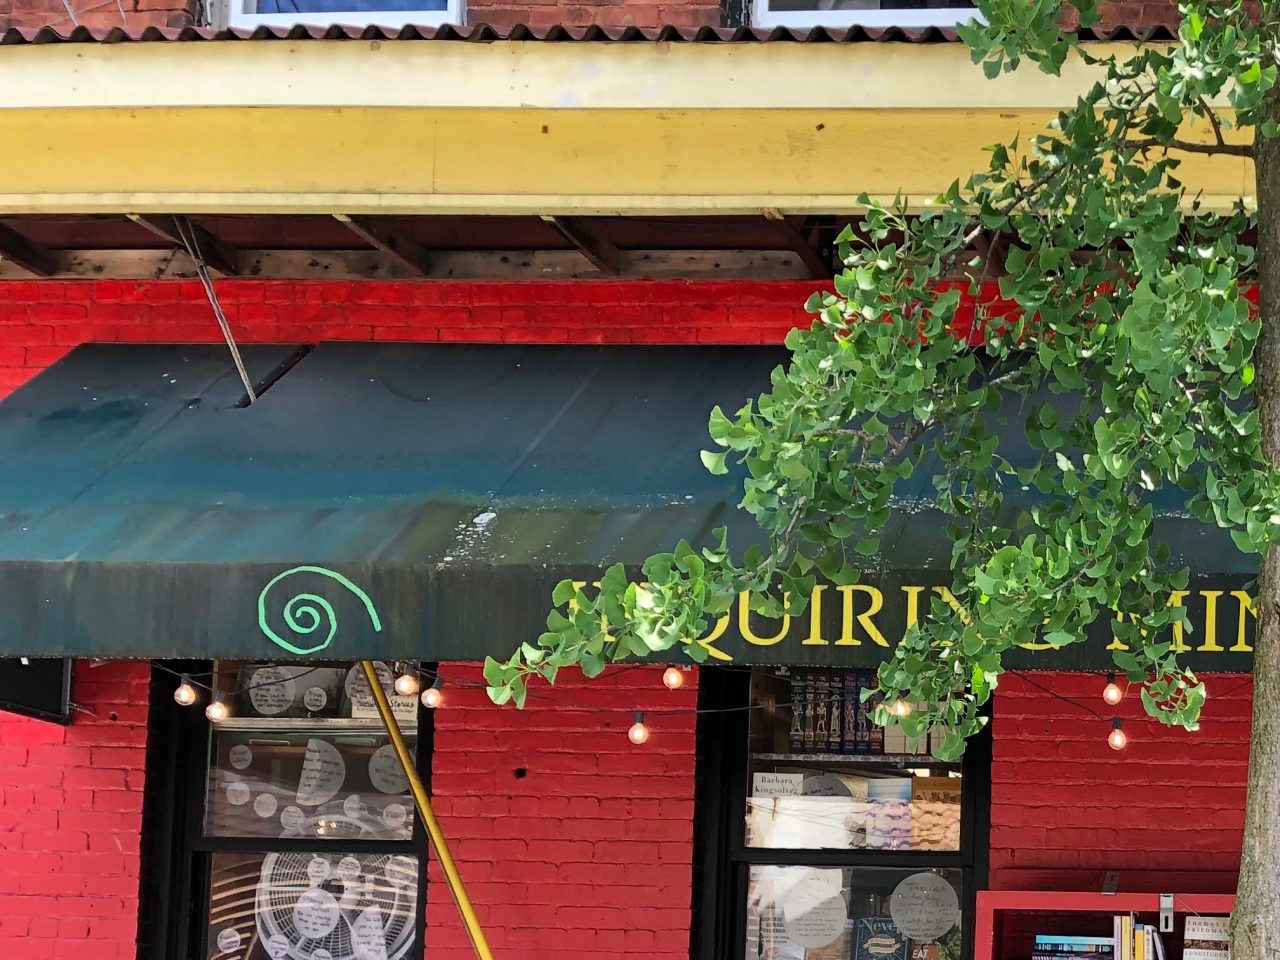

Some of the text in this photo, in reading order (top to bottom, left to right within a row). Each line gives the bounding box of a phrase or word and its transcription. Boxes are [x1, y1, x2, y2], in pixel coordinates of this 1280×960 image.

[566, 581, 1062, 661] QUIRI
[761, 775, 793, 784] Barbara
[1187, 920, 1220, 928] THOMAS
[912, 949, 929, 959] EAT
[1184, 950, 1227, 958] LONGITUDES
